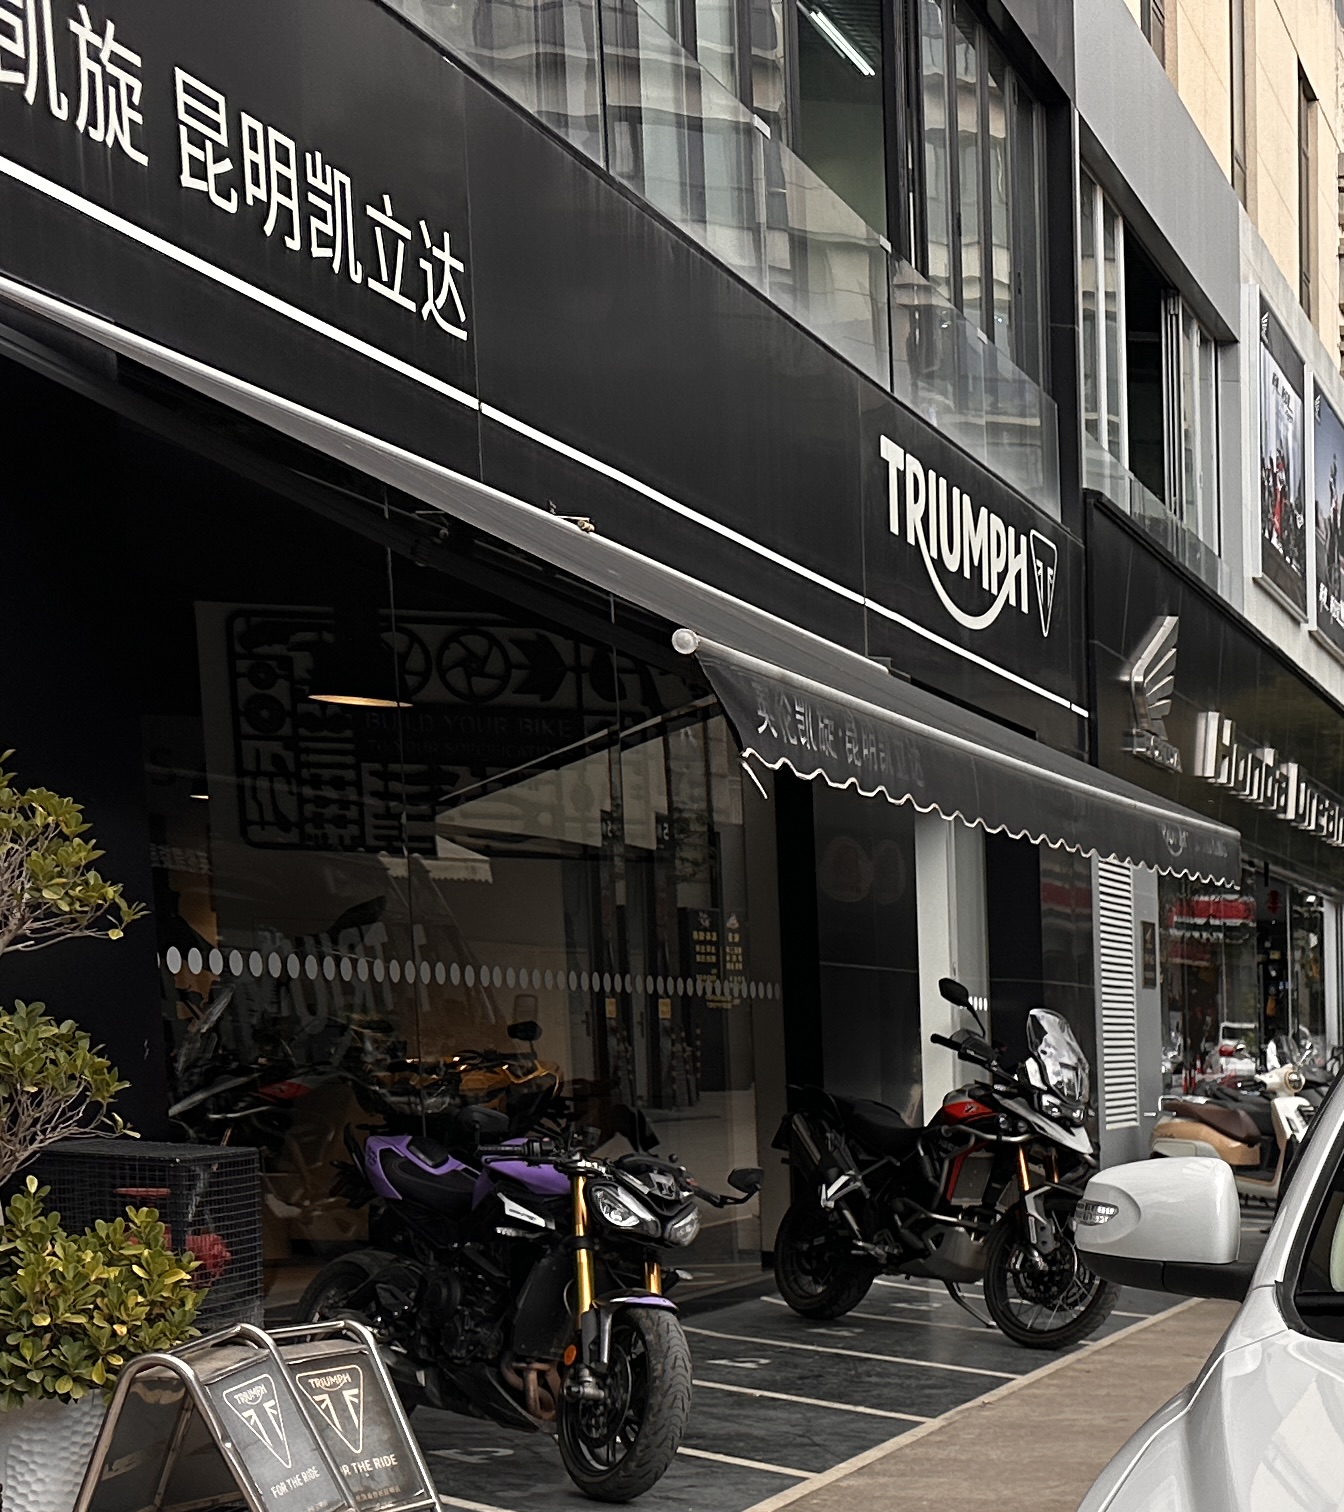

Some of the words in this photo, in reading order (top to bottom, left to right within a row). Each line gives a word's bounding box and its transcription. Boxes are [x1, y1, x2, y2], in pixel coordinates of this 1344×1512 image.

[174, 67, 469, 341] 昆明凯立达
[880, 434, 1029, 630] TRIUMPH
[234, 1384, 268, 1406] TRIUMPH
[308, 1373, 353, 1391] TRIUMPH
[351, 1459, 373, 1475] THE
[375, 1454, 399, 1470] RIDE
[270, 1481, 288, 1499] FOR
[285, 1475, 303, 1493] THE
[300, 1466, 321, 1485] RIDE
